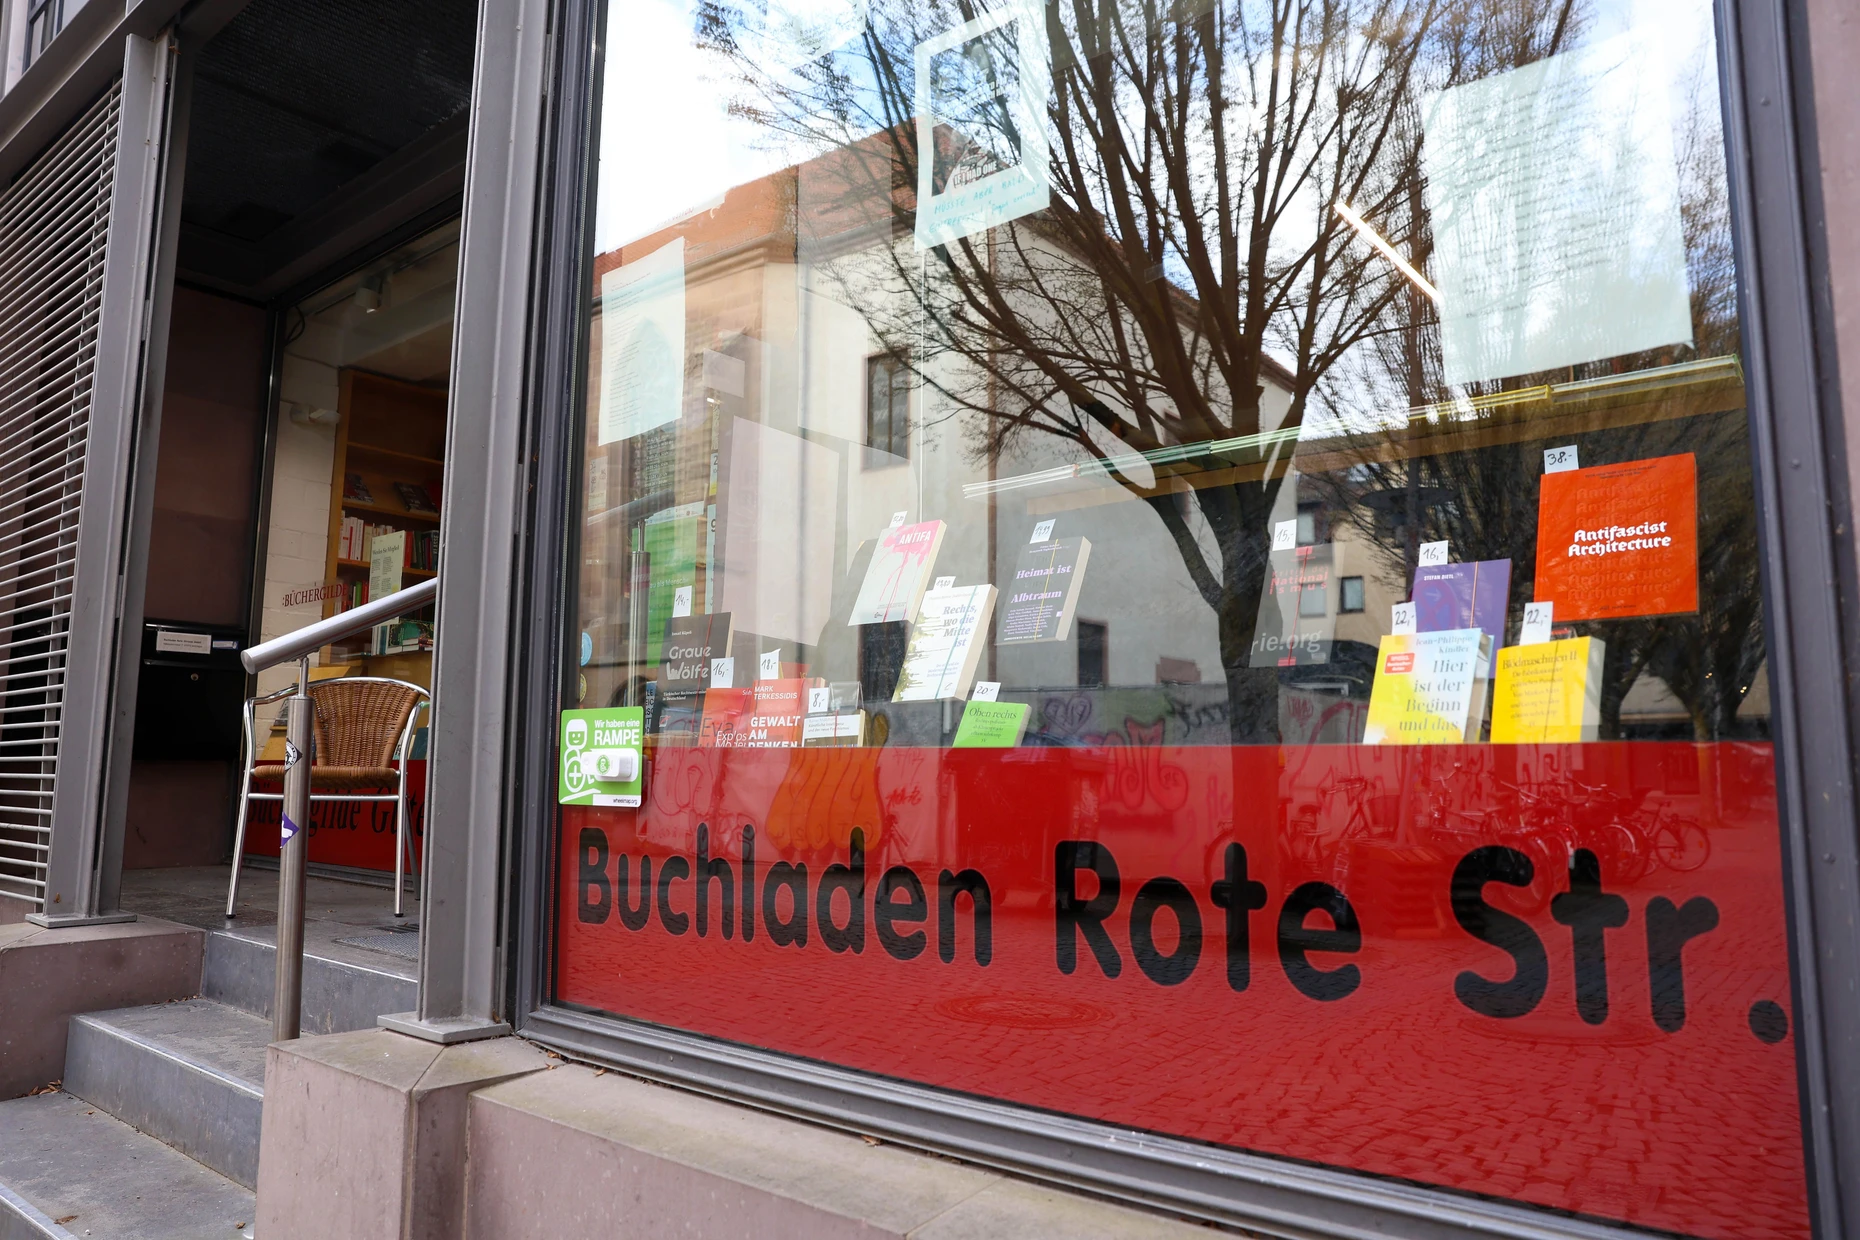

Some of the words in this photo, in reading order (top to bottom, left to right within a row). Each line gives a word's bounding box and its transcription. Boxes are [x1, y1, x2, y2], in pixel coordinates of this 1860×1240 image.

[900, 530, 931, 545] ANTIFA
[1574, 521, 1667, 542] Antifascist
[1568, 536, 1672, 557] Architecture
[1016, 566, 1054, 579] Heimat
[1056, 565, 1072, 574] ist
[1011, 590, 1062, 603] Albtraum
[943, 604, 977, 615] Rechts,
[944, 619, 958, 627] wo
[943, 627, 970, 637] Mitte
[954, 638, 966, 648] ist
[668, 646, 711, 660] Graue
[1433, 660, 1468, 672] Hier
[1502, 652, 1568, 669] Blödmaschinen
[666, 661, 709, 681] Wölfe
[1414, 680, 1431, 692] ist
[1438, 679, 1464, 692] der
[754, 692, 797, 700] TERKESSIDIS
[1406, 699, 1460, 712] Beginn
[969, 708, 991, 718] Oben
[992, 710, 1016, 719] rechts
[595, 720, 605, 728] Wir
[606, 719, 625, 727] haben
[626, 719, 640, 727] eine
[701, 717, 734, 738] Eva
[751, 716, 801, 727] GEWALT
[1399, 718, 1428, 731] und
[1432, 718, 1458, 731] das
[594, 729, 640, 746] RAMPE
[749, 729, 768, 739] AM
[577, 822, 992, 967] Buchladen
[1054, 840, 1363, 1001] Rote
[1450, 844, 1789, 1044] Str.
